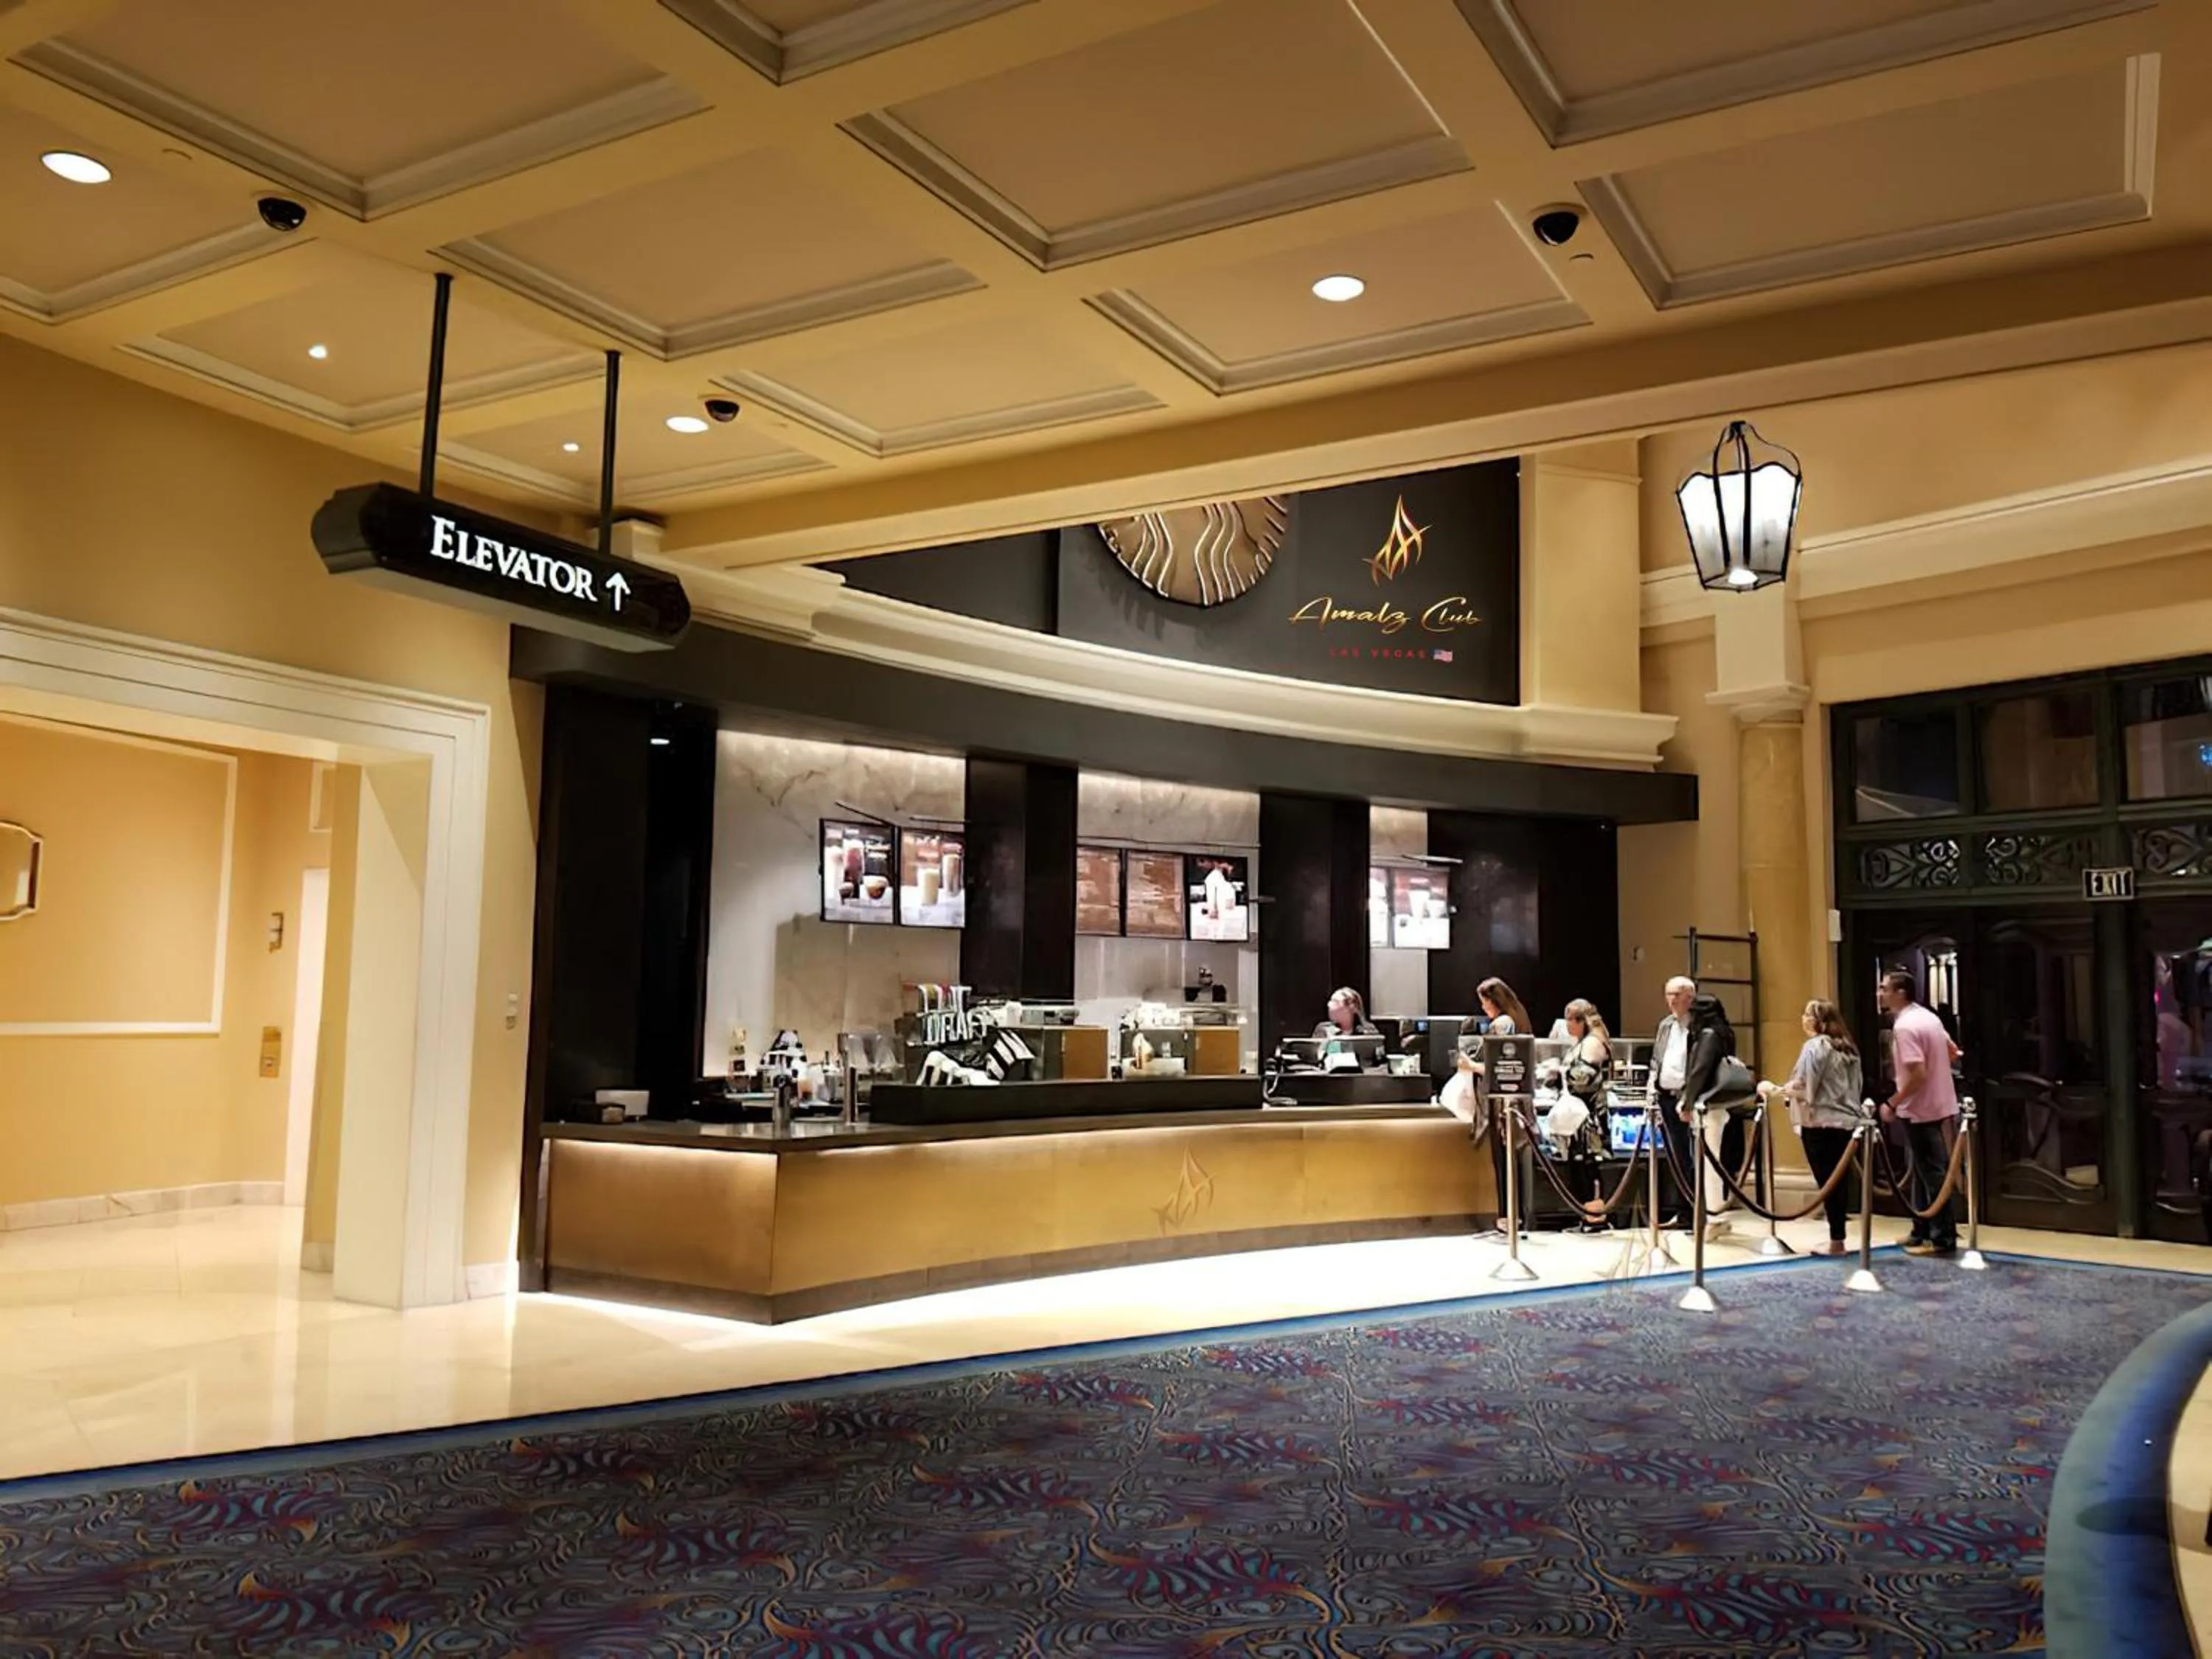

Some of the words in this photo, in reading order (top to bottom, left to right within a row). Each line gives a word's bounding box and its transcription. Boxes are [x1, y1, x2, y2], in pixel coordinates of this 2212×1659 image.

[430, 515, 599, 602] ELEVATOR
[1370, 648, 1427, 659] VEGAS
[2090, 872, 2128, 896] EXIT
